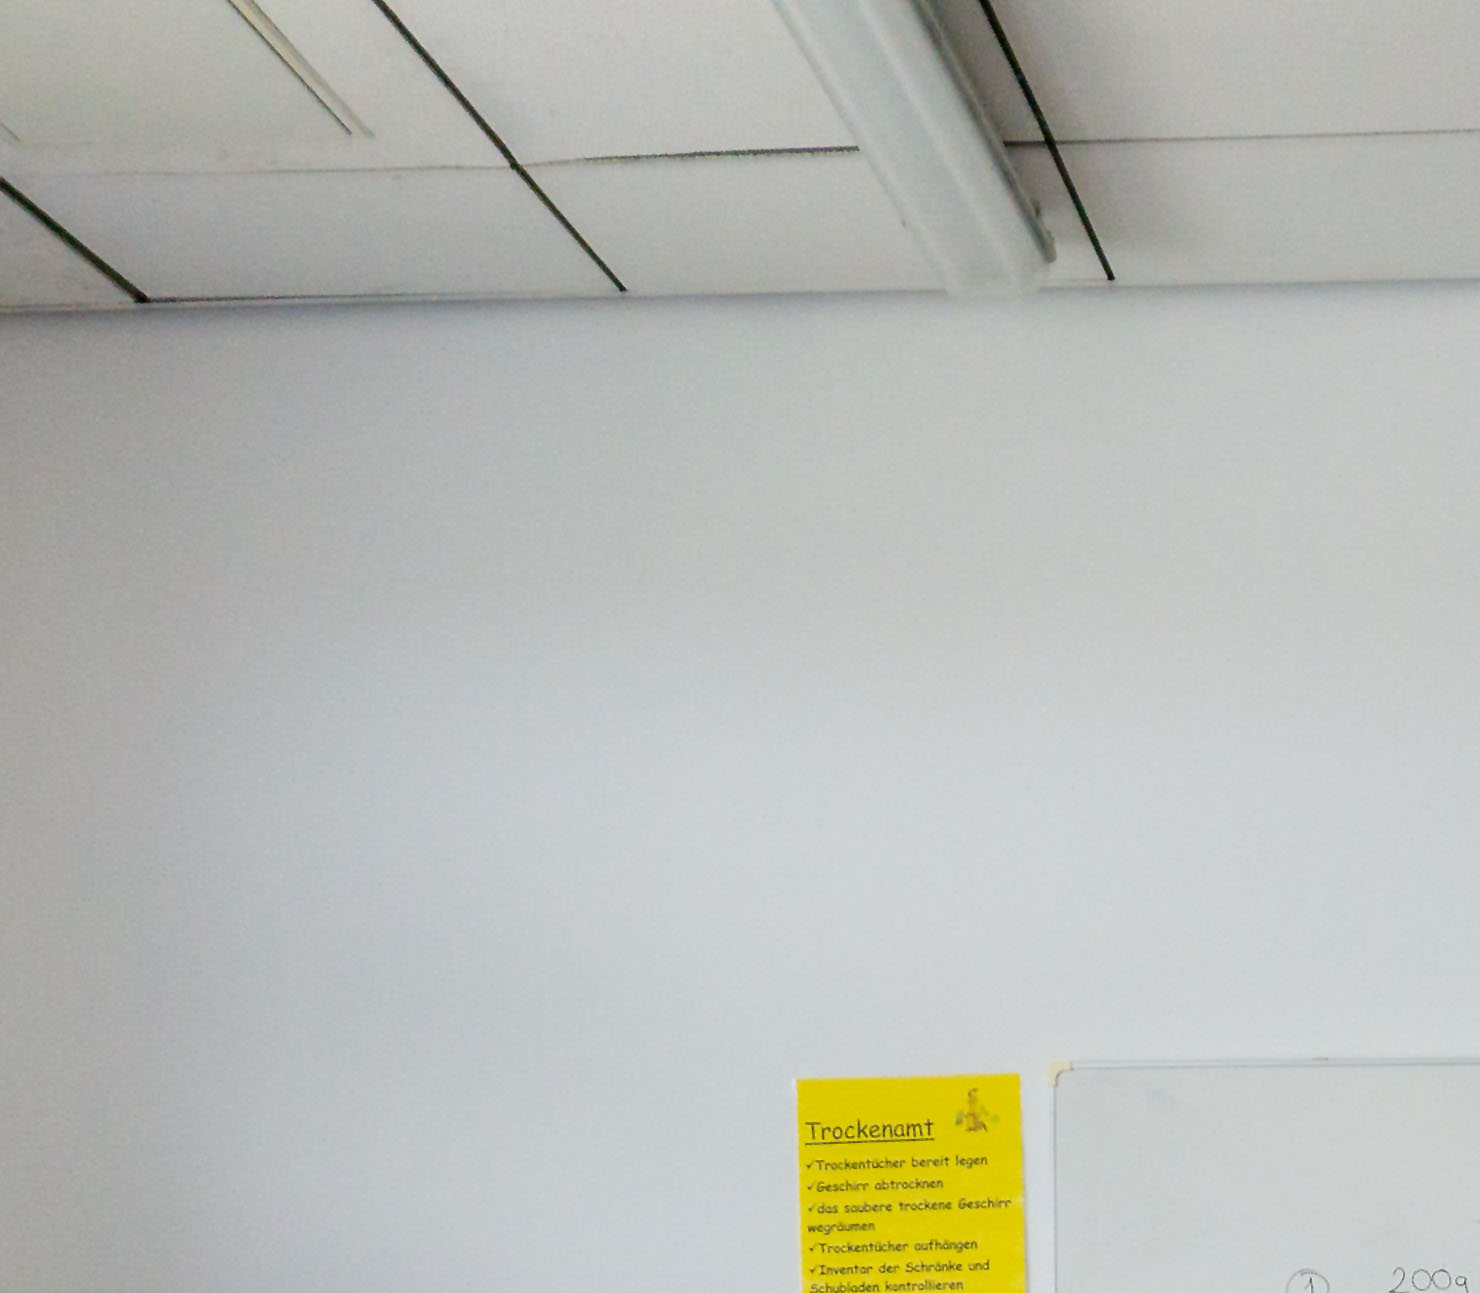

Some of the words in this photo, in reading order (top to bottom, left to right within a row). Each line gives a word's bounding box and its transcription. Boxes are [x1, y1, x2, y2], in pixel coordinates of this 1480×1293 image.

[805, 1120, 934, 1141] Trockenamt
[816, 1158, 906, 1170] Trockentücher
[911, 1156, 949, 1168] bereit
[955, 1155, 988, 1168] legen
[816, 1181, 869, 1192] Geschirr
[874, 1178, 943, 1190] abtrocknen
[817, 1203, 838, 1214] das
[844, 1201, 892, 1213] saubere
[898, 1200, 952, 1211] trockene
[957, 1199, 1011, 1210] Geschirr
[807, 1221, 875, 1234] wegräumen
[819, 1242, 908, 1254] Trockentücher
[914, 1240, 978, 1253] aufhängen
[819, 1264, 872, 1275] Inventar
[878, 1263, 900, 1273] der
[905, 1261, 962, 1272] Schränke
[967, 1260, 989, 1271] und
[809, 1282, 879, 1293] Schubladen
[884, 1280, 963, 1292] kontrollieren
